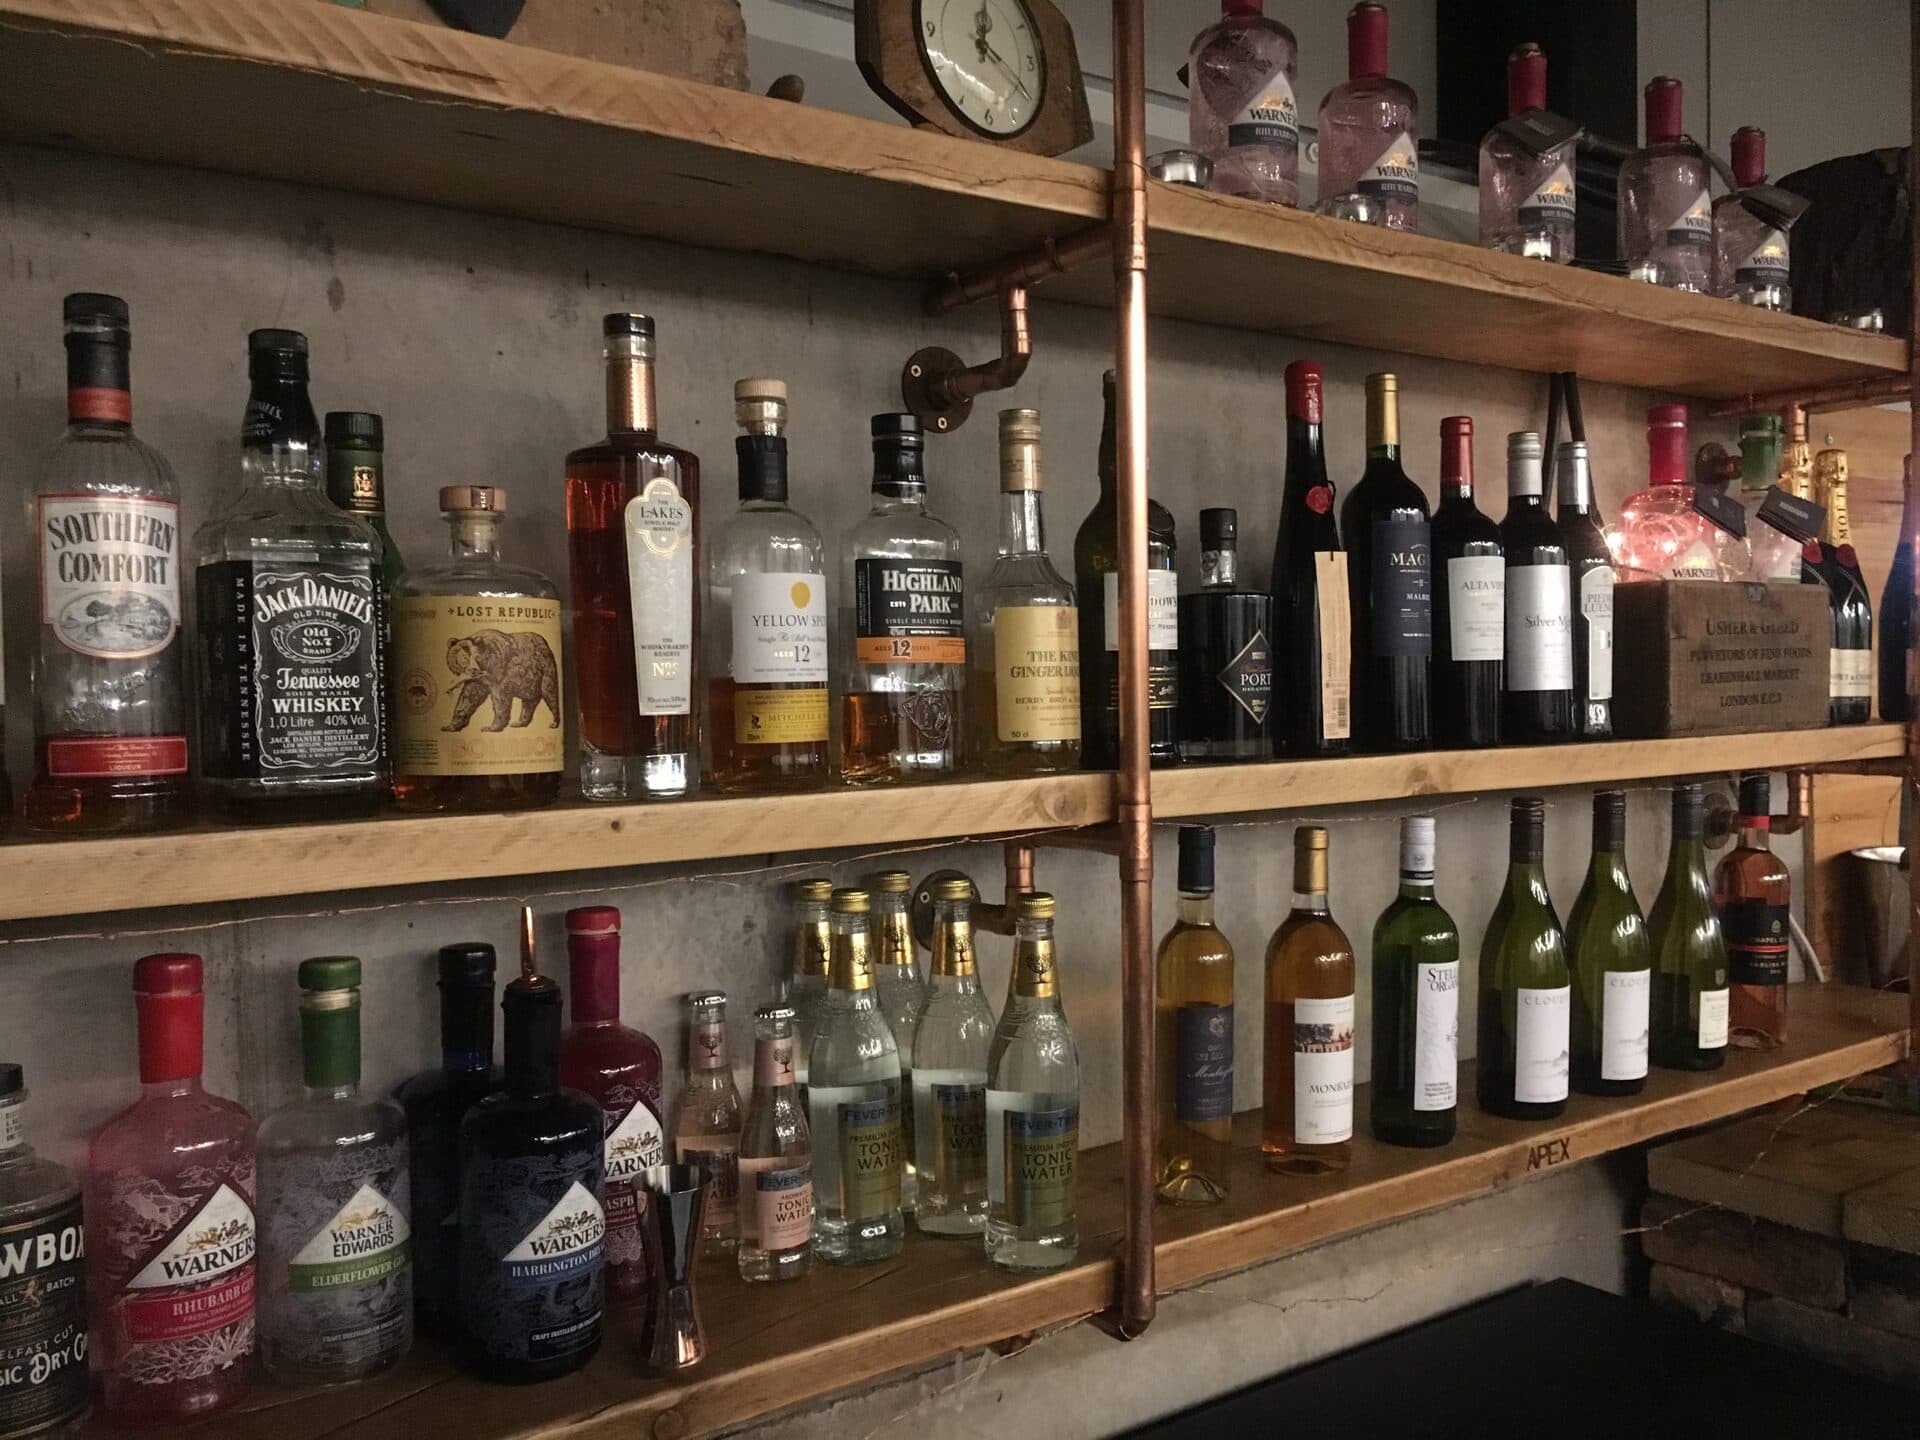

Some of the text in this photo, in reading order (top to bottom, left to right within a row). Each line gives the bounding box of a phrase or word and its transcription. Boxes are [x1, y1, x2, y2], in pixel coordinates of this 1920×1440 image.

[640, 506, 683, 519] LAKES
[47, 510, 174, 554] SOUTHERN
[58, 551, 169, 584] COMFORT
[882, 570, 962, 593] HIGHLAND
[254, 578, 375, 624] JACK DANIEL'S
[910, 594, 951, 613] PARK
[293, 609, 338, 620] OLD TIME
[457, 606, 552, 619] LOST REPUBLIC
[752, 614, 809, 628] YELLOW
[1525, 615, 1556, 629] Silver
[304, 628, 329, 637] Old
[794, 645, 810, 663] 12
[892, 640, 911, 658] 12
[1027, 651, 1056, 662] THE
[236, 578, 250, 761] MADE IN TENNESSEE
[276, 668, 360, 690] Tennessee
[1010, 666, 1063, 678] GINGER
[1241, 673, 1272, 686] PORT
[272, 697, 364, 714] WHISKEY
[290, 716, 314, 728] Litre
[324, 715, 348, 727] 40%
[1024, 1147, 1072, 1167] TONIC
[1527, 1137, 1571, 1171] APEX
[1021, 1161, 1073, 1180] WATER
[330, 1219, 394, 1244] WARNER
[333, 1231, 394, 1258] EDWARDS
[312, 1260, 392, 1287] ELDERFLOWER
[511, 1254, 588, 1278] HARRINGTON
[46, 1276, 75, 1292] BATCH
[173, 1284, 241, 1316] RHUBARB
[54, 1324, 74, 1345] CUT
[30, 1347, 71, 1384] DRY
